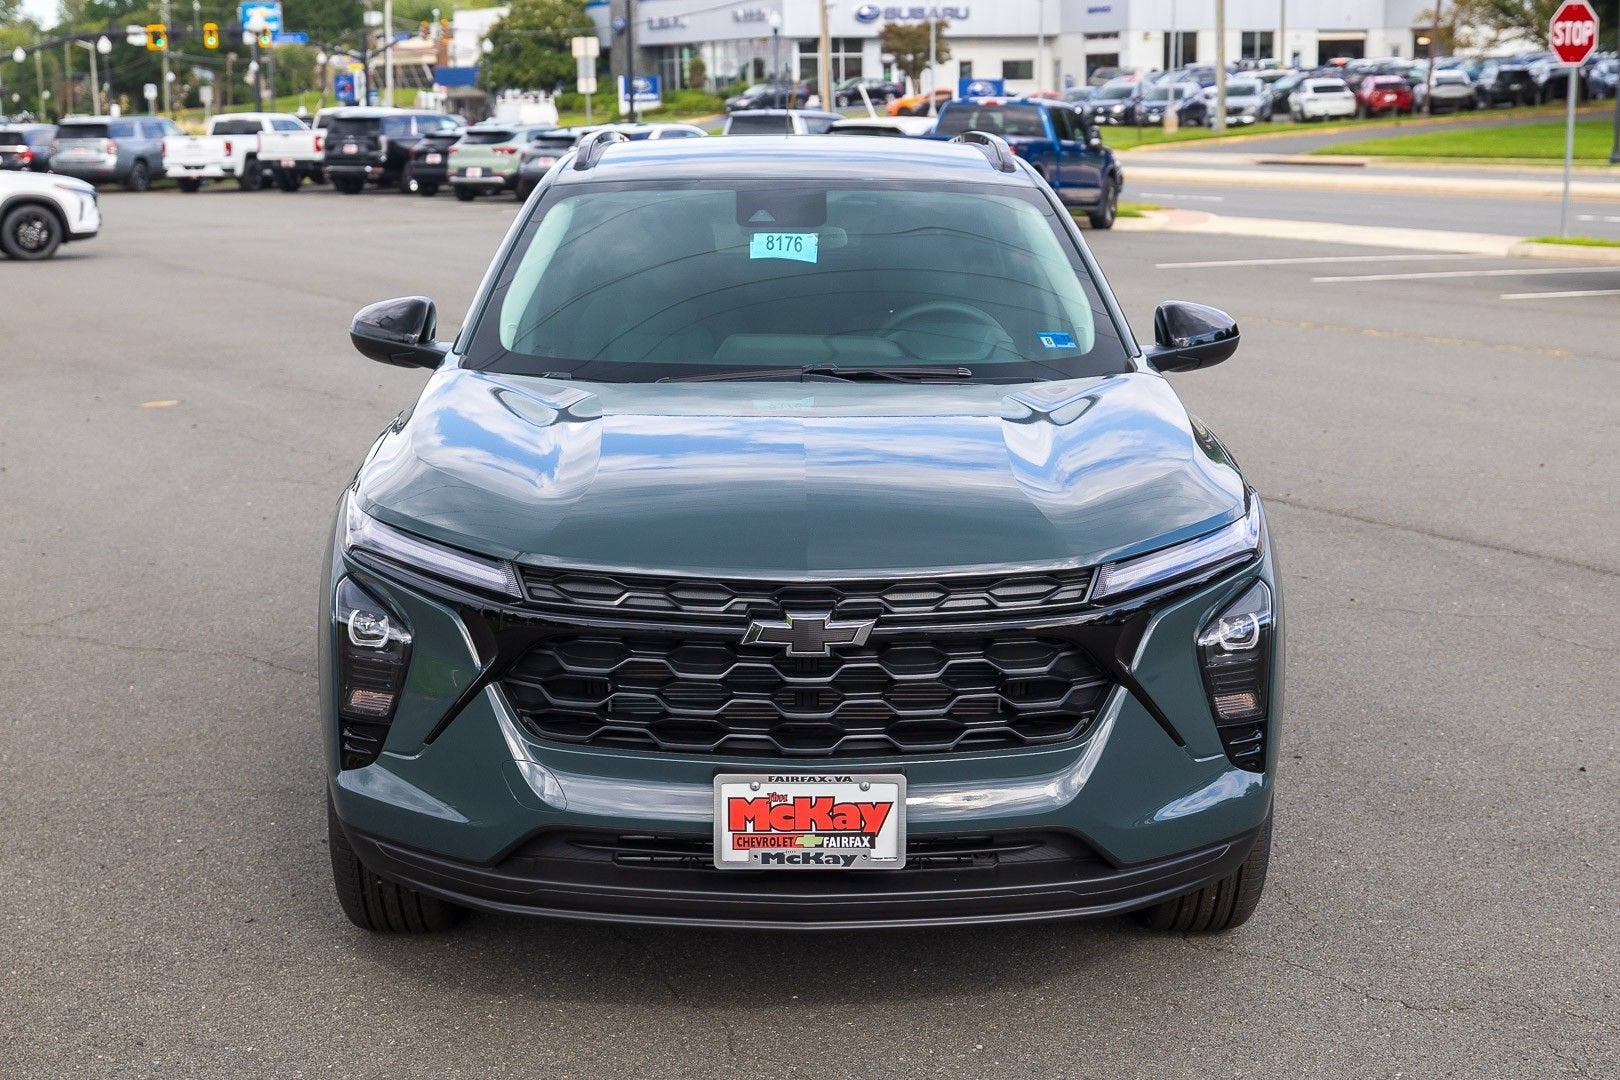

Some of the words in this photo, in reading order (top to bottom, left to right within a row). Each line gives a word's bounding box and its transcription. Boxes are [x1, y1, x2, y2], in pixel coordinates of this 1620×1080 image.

[883, 6, 969, 20] SUBARU
[1553, 20, 1594, 47] STOP
[766, 234, 803, 253] 8176
[728, 796, 894, 837] McKay
[736, 836, 794, 848] CHEVROLET
[823, 836, 871, 848] FAIRFAX
[761, 852, 858, 867] McKay
